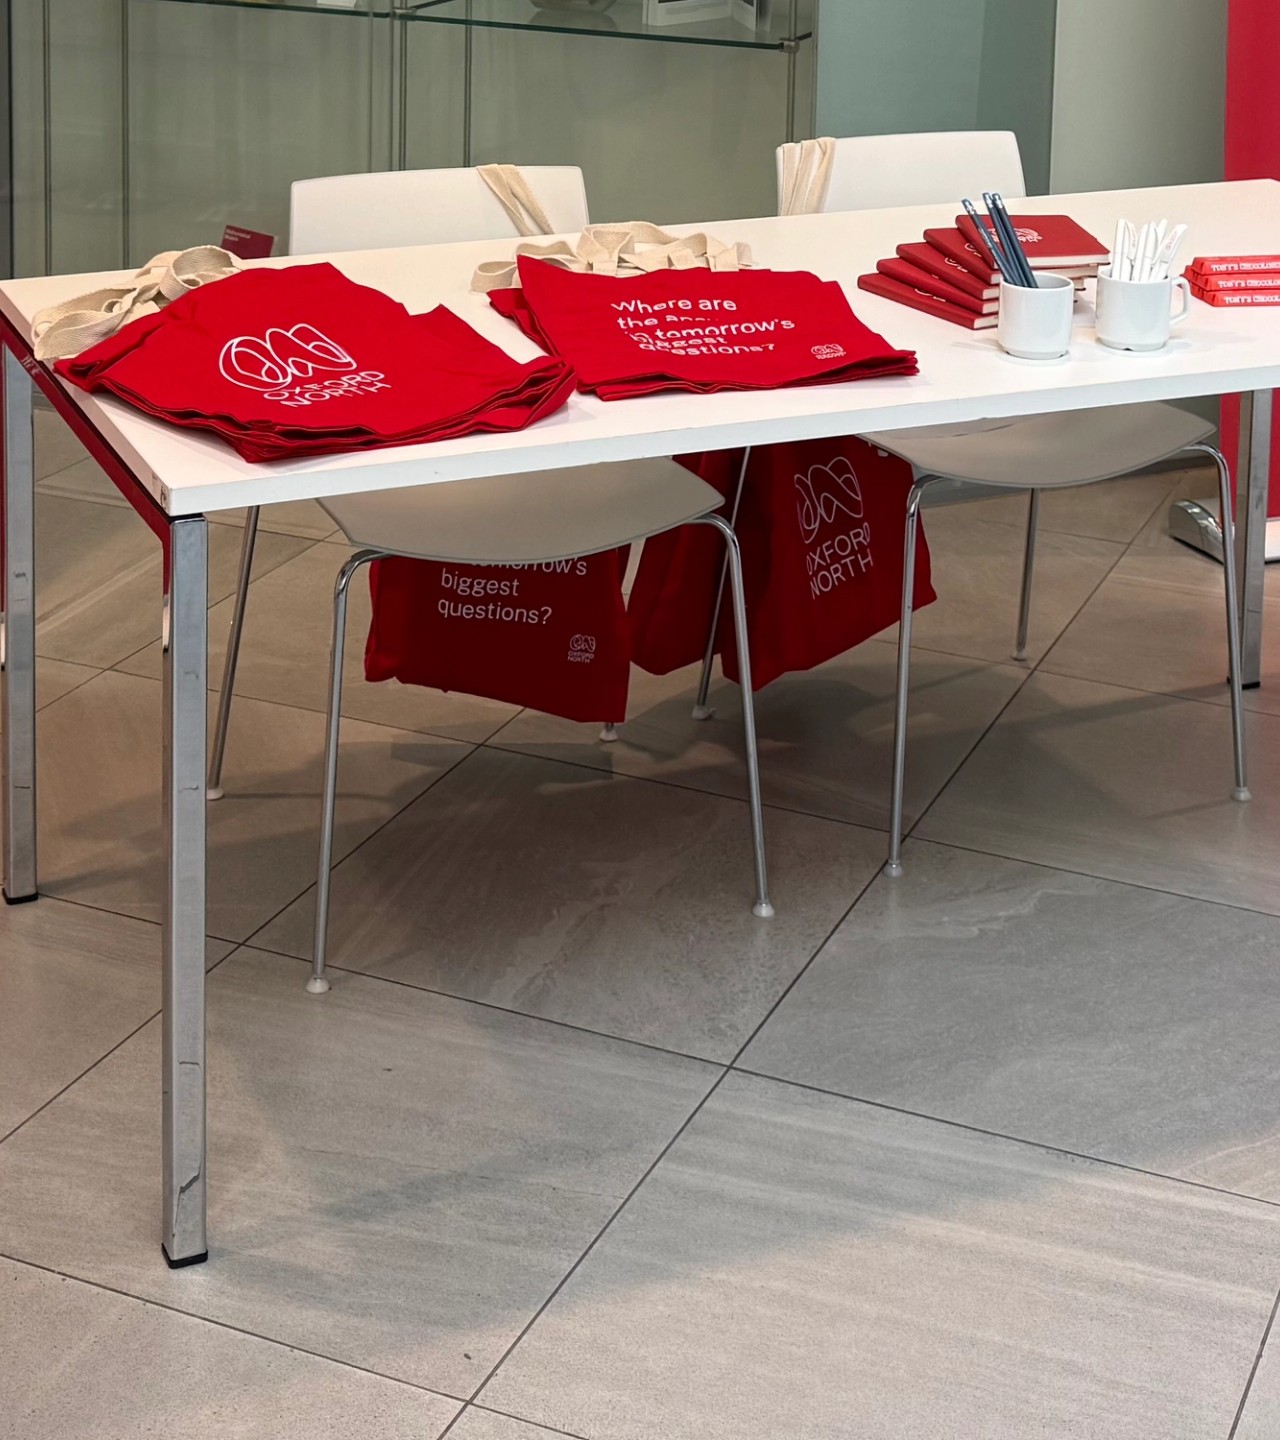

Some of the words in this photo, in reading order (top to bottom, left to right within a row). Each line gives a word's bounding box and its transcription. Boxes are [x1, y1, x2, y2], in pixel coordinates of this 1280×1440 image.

[610, 298, 693, 314] Where
[698, 299, 738, 311] are
[617, 316, 659, 329] the
[655, 319, 796, 340] tomorrow's
[263, 371, 385, 400] OXFORD
[280, 381, 392, 408] NORTH
[806, 521, 871, 576] OXFORD
[441, 567, 520, 597] biggest
[810, 548, 874, 600] NORTH
[437, 598, 553, 625] questions?
